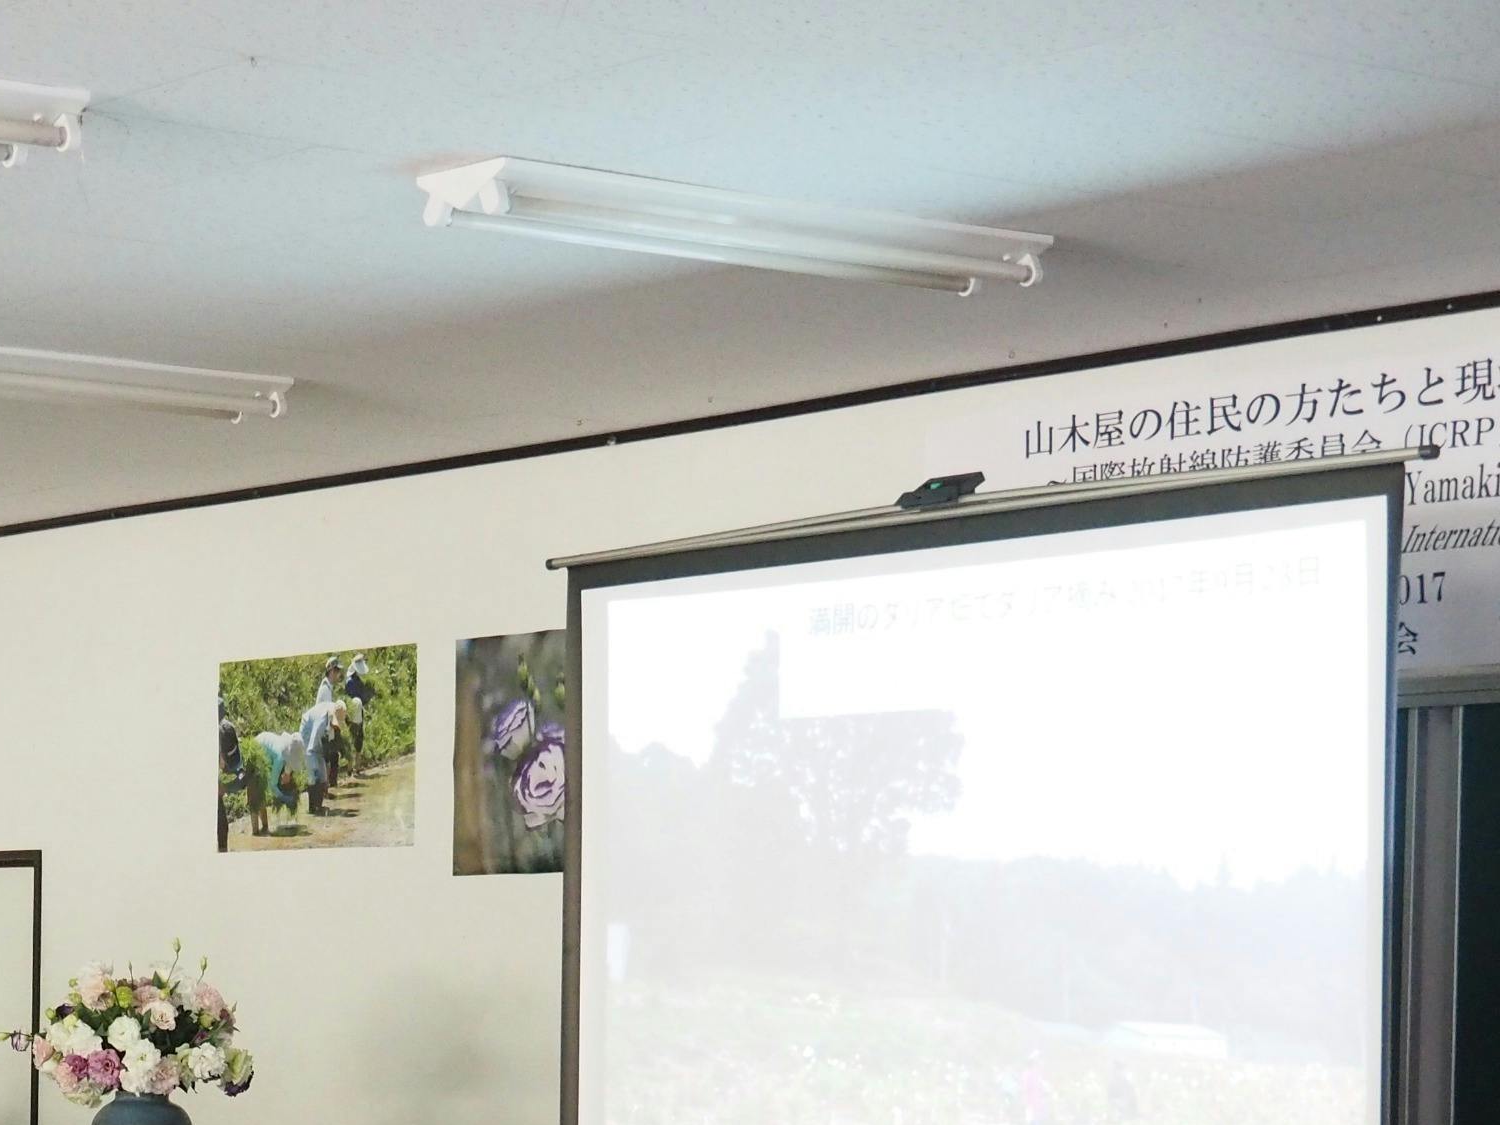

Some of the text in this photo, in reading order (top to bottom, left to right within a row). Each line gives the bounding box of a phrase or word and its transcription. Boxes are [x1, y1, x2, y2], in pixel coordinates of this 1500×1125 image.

[1025, 358, 1500, 458] 山木屋の住民の方たちと現
[1402, 518, 1500, 554] Internati
